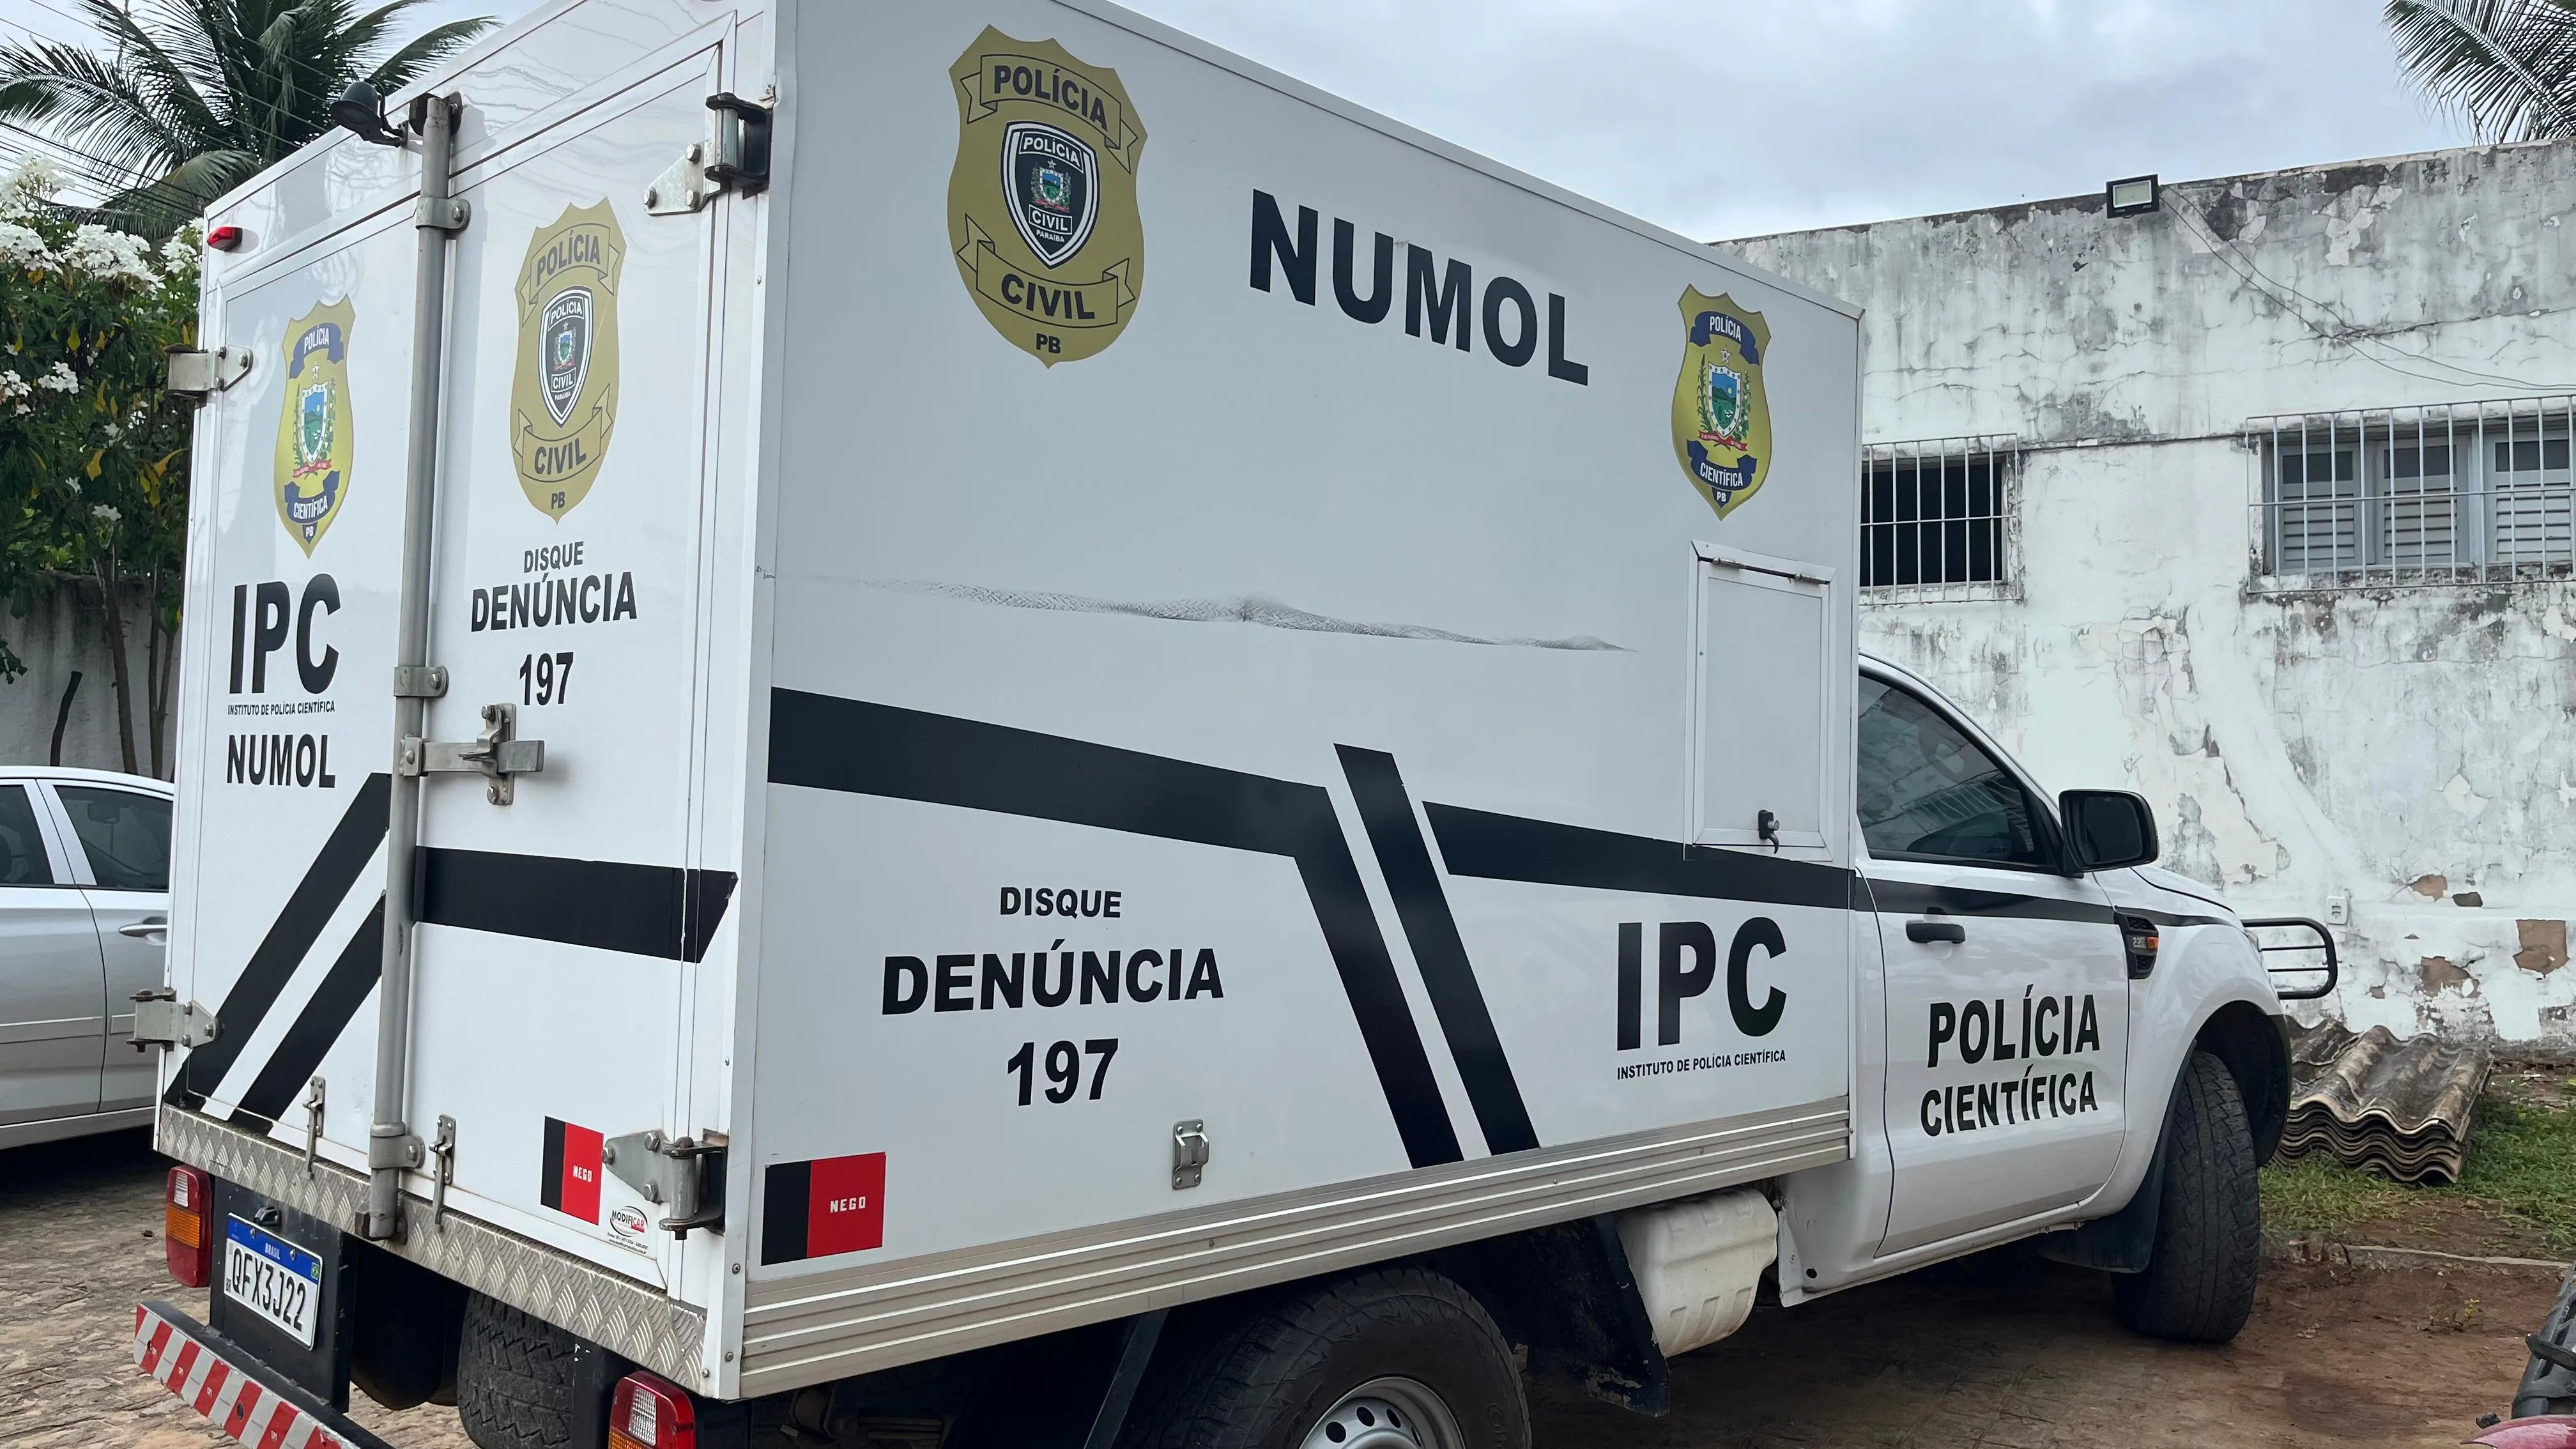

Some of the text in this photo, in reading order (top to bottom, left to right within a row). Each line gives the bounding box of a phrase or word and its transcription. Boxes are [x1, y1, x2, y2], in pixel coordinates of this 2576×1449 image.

[993, 65, 1108, 132] POLÍCIA
[1023, 137, 1080, 167] POLÍCIA
[1032, 210, 1068, 231] CIVIL
[1036, 229, 1065, 242] PARAÍBA
[536, 230, 601, 287] POLÍCIA
[1001, 273, 1095, 319] CIVIL
[1250, 188, 1588, 386] NUMOL
[551, 300, 583, 325] POLÍCIA
[1710, 315, 1742, 341] POLÍCIA
[303, 326, 330, 354] POLÍCIA
[1036, 333, 1061, 354] PB
[553, 372, 574, 390] CIVIL
[534, 438, 586, 474] CIVIL
[1700, 462, 1743, 487] CIENTÍFICA
[294, 495, 328, 519] CIENTÍFICA
[551, 491, 565, 509] PB
[1716, 491, 1726, 502] PB
[305, 526, 314, 537] PB
[524, 541, 584, 573] DISQUE
[471, 571, 637, 632] DENÚNCIA
[229, 574, 341, 694] IPC
[519, 652, 574, 705] 197
[227, 699, 335, 715] INSTITUTO DE POLÍCIA CIENTÍFICA
[227, 734, 335, 788] NUMOL
[1000, 887, 1122, 919] DISQUE
[882, 939, 1224, 1015] DENÚNCIA
[1617, 917, 1786, 1051] IPC
[1927, 984, 2100, 1068] POLÍCIA
[1008, 1038, 1119, 1107] 197
[1617, 1048, 1786, 1080] INSTITUTO DE POLÍCIA CIENTÍFICA
[1920, 1063, 2098, 1137] CIENTÍFICA
[573, 1165, 593, 1182] NEGO
[611, 1209, 645, 1229] MODIFICAR
[830, 1196, 866, 1213] NEGO
[264, 1243, 280, 1260] BRASIL
[233, 1248, 306, 1331] QFX3J22
